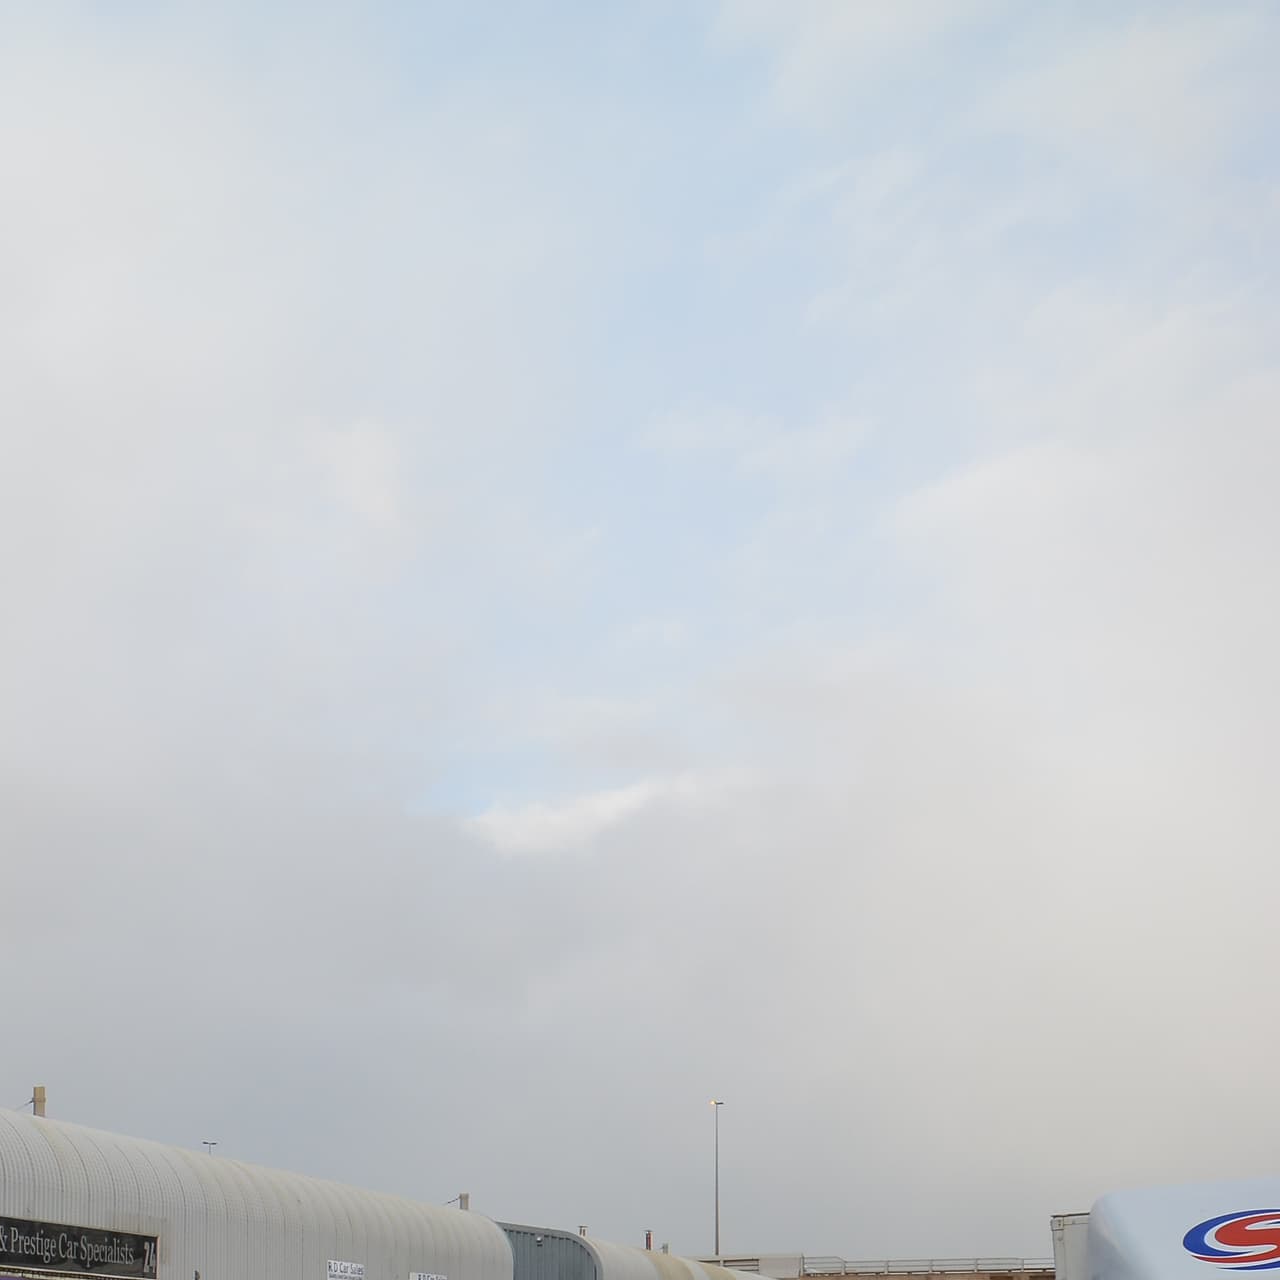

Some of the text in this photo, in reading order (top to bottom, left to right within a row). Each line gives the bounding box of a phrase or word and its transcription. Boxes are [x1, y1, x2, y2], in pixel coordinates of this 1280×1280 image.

[10, 1227, 56, 1263] Prestige
[59, 1232, 78, 1259] Car
[80, 1235, 134, 1267] Specialists
[144, 1242, 156, 1273] 24
[340, 1262, 349, 1274] Car
[351, 1264, 363, 1275] Sales
